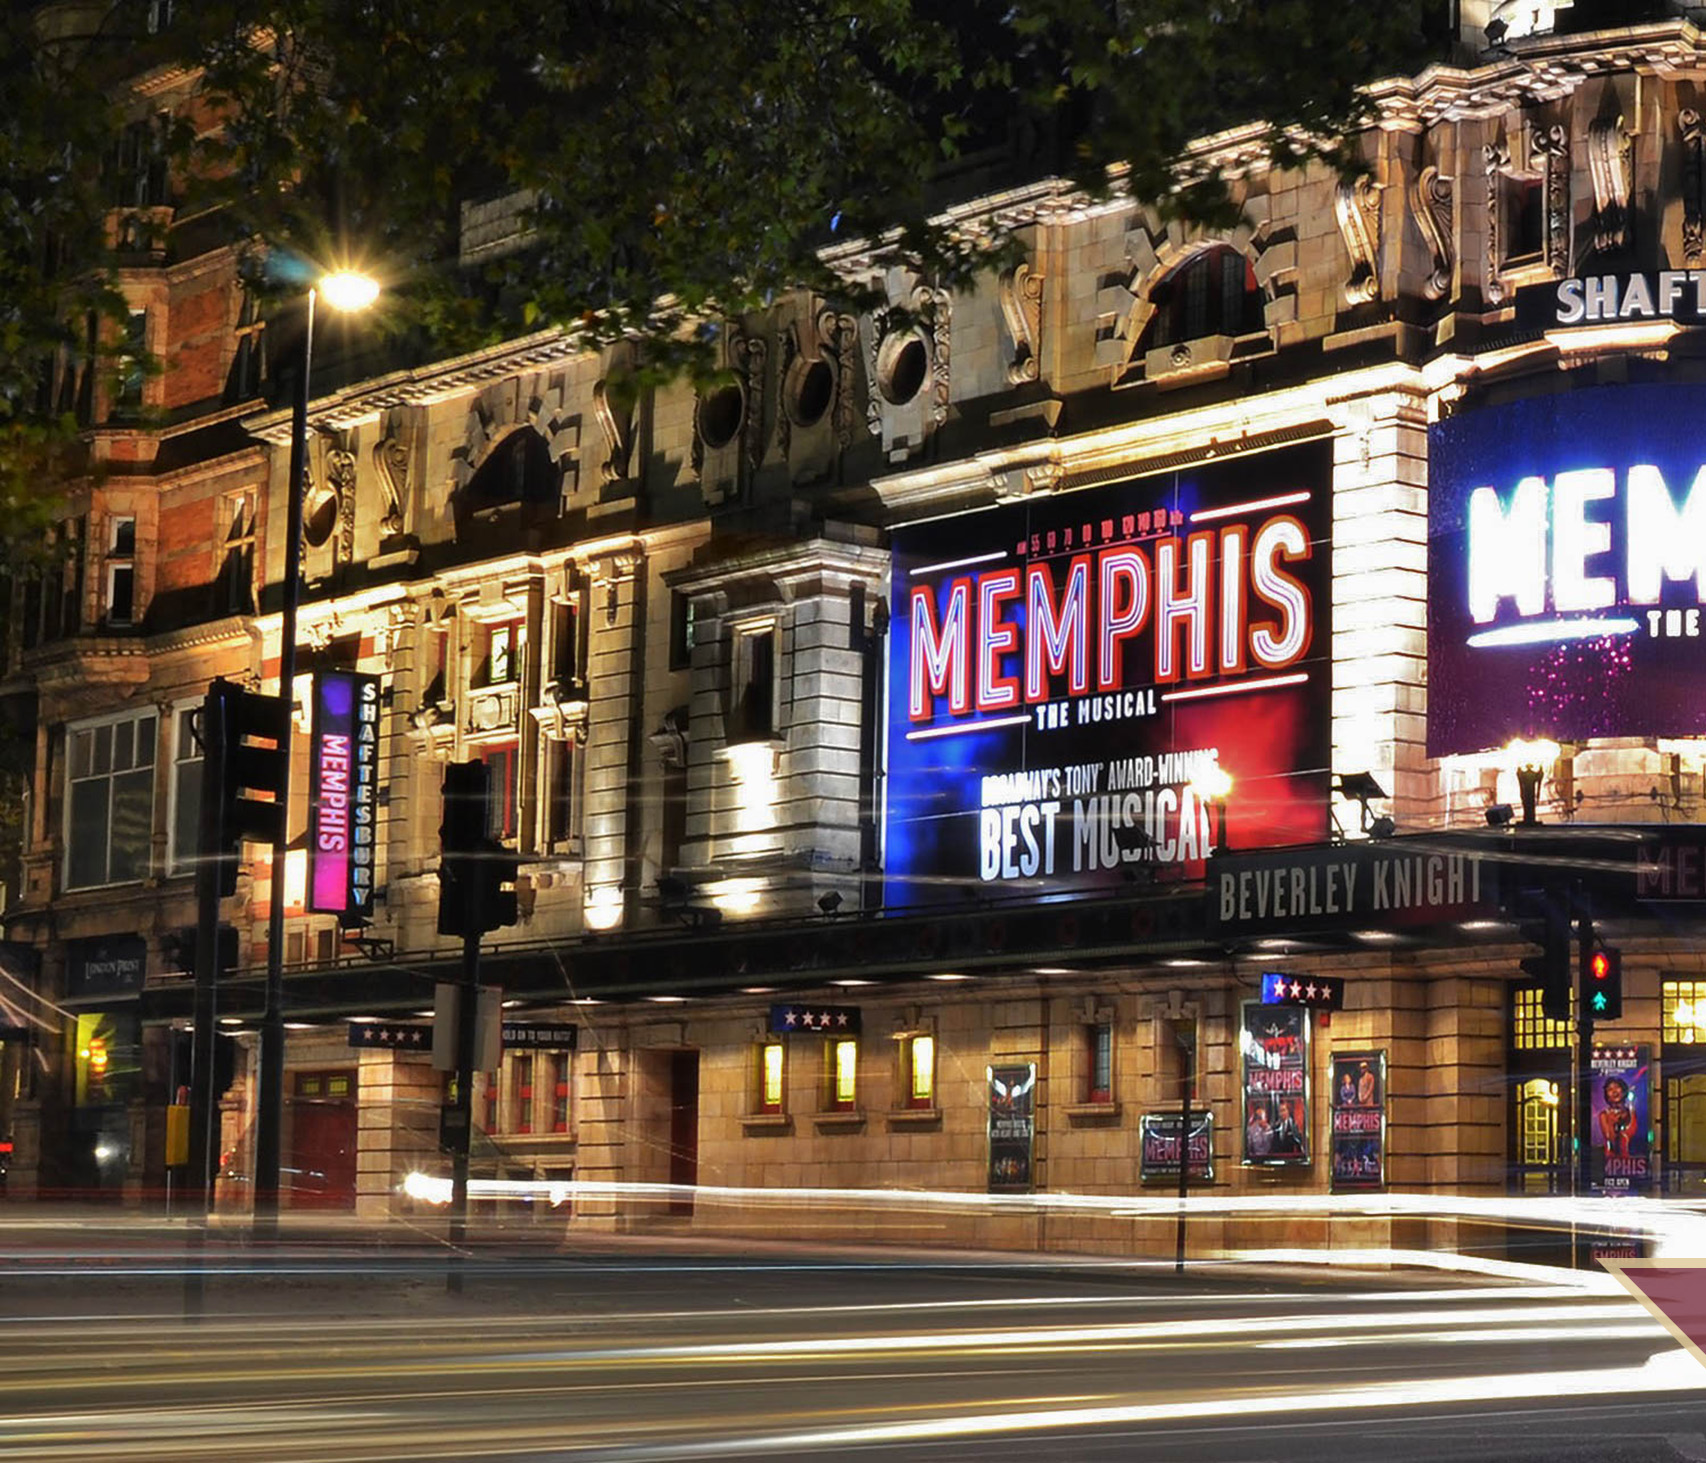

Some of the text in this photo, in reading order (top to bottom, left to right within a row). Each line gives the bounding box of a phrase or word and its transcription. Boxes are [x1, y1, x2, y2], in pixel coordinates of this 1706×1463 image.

[909, 514, 1311, 722] MEMPHIS
[1646, 609, 1700, 638] THE
[1036, 690, 1157, 731] THE MUSICAL
[318, 734, 349, 851] MEMPHIS
[353, 682, 377, 906] SHAFTESBURY
[980, 801, 1061, 882] BEST
[1220, 854, 1480, 921] BEVERLEY KNIGHT
[1249, 1070, 1303, 1090] MEMPHIS
[1333, 1112, 1380, 1130] MEMPHIS
